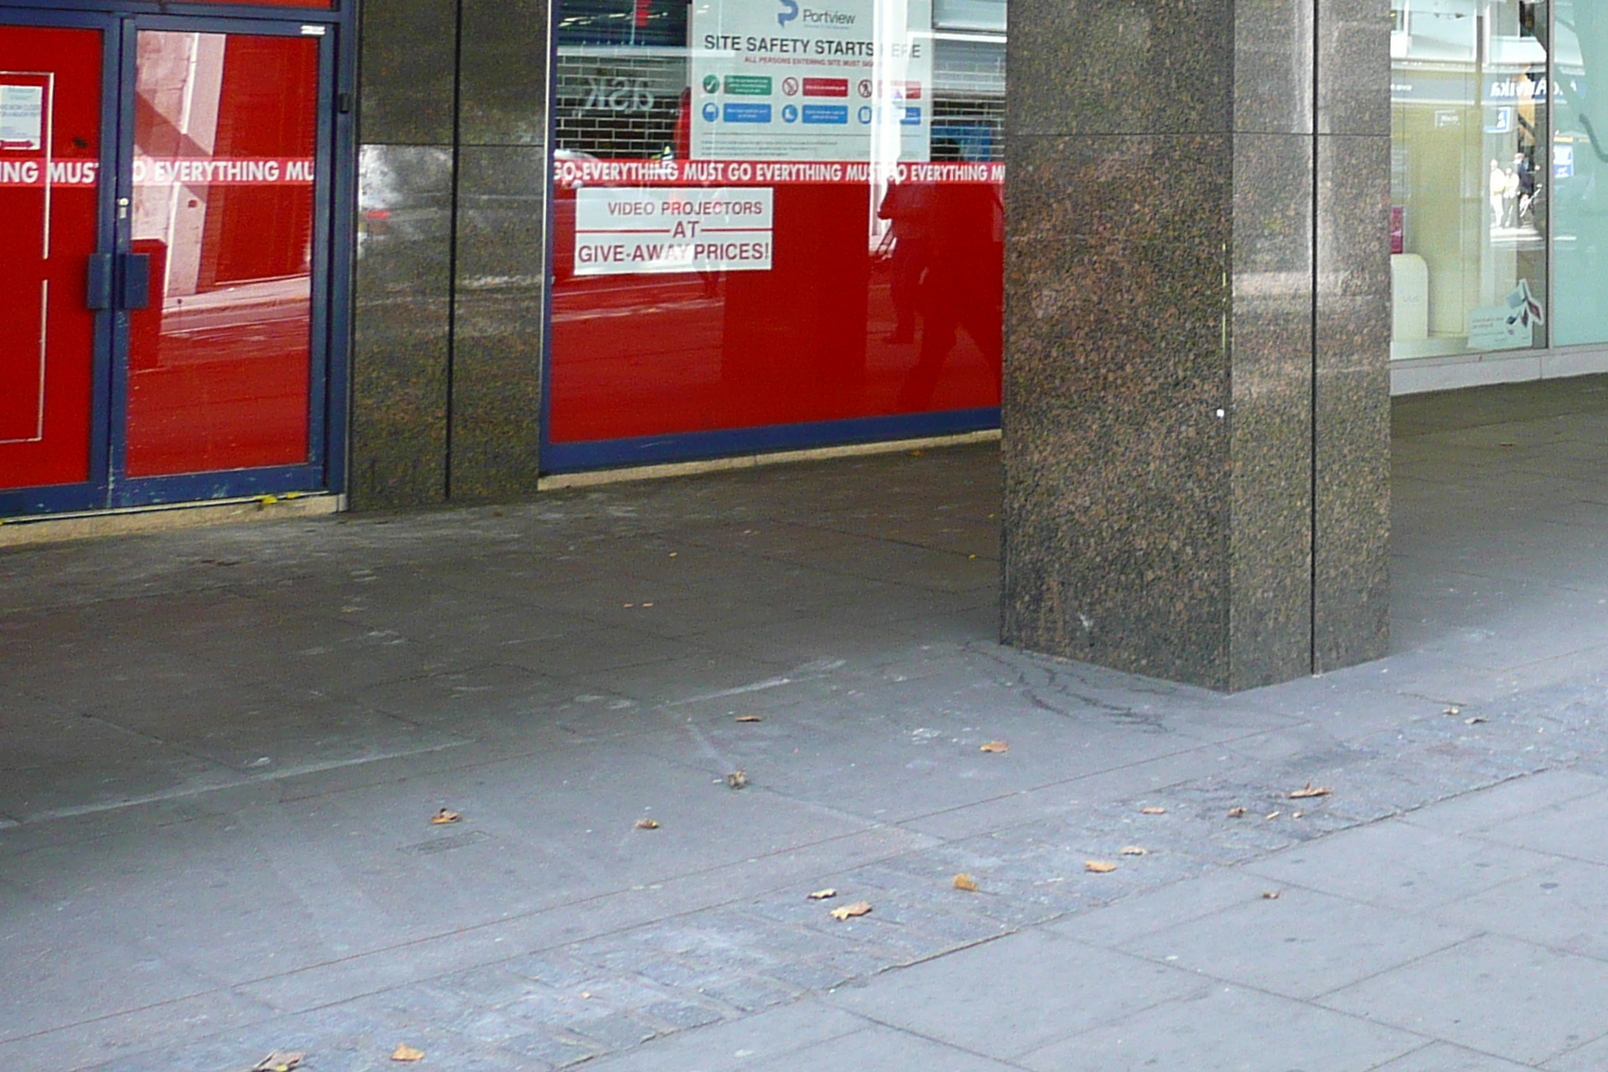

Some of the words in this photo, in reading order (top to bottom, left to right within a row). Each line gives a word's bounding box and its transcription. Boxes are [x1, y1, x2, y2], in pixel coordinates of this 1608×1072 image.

[803, 9, 856, 26] Portview
[704, 34, 741, 52] SITE
[746, 37, 809, 54] SAFETY
[815, 39, 873, 57] STARTS
[154, 161, 279, 182] EVERYTHING
[582, 163, 679, 181] EVERYTHING
[683, 164, 724, 181] MUST
[728, 164, 751, 181] GO
[756, 164, 841, 182] EVERYTHING
[911, 166, 989, 182] EVERYTHING
[608, 202, 655, 216] VIDEO
[661, 202, 763, 216] PROJECTORS
[673, 220, 699, 238] AT
[579, 243, 692, 262] GIVE-AWAY
[694, 242, 769, 260] PRICES!
